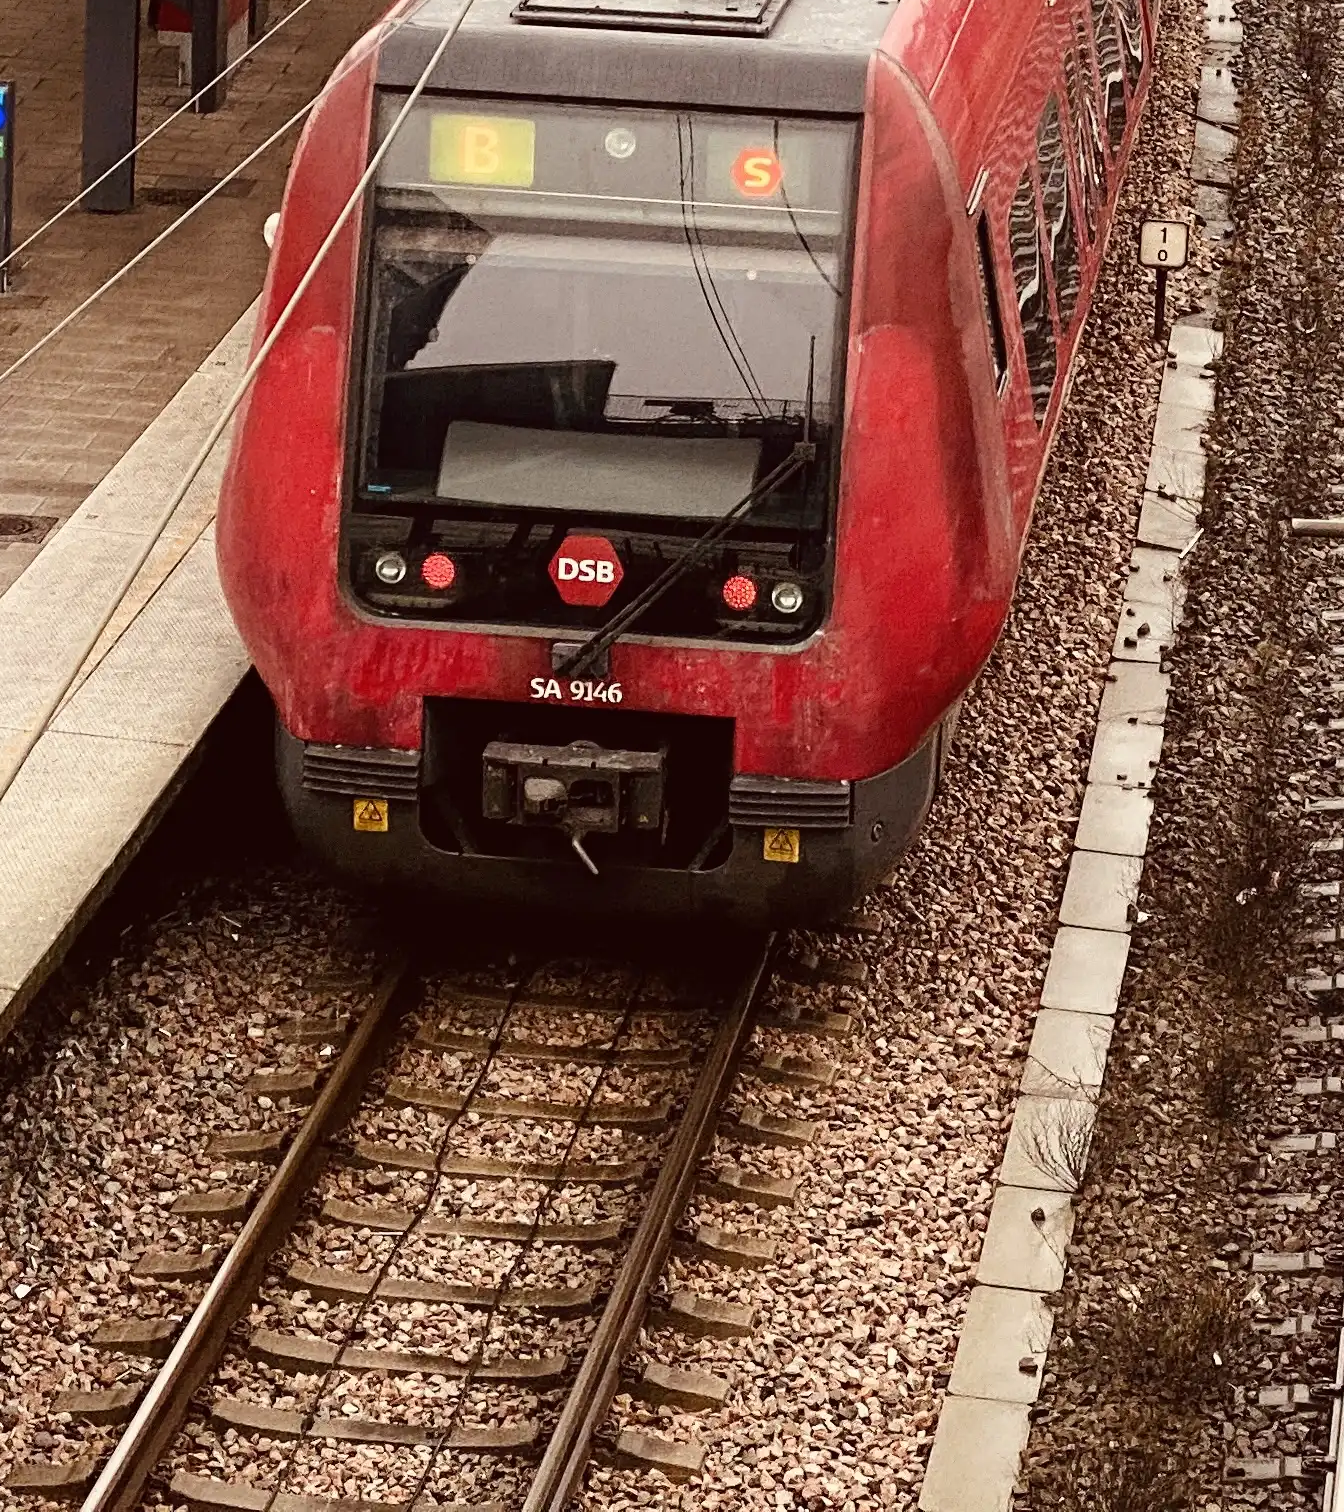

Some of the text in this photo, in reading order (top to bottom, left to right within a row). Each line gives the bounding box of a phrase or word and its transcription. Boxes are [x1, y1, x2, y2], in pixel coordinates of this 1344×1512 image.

[464, 126, 499, 174] B
[743, 157, 772, 187] S
[1160, 227, 1167, 244] 1
[1158, 249, 1168, 262] 0
[558, 557, 614, 583] DSB
[530, 677, 623, 703] SA 9146
